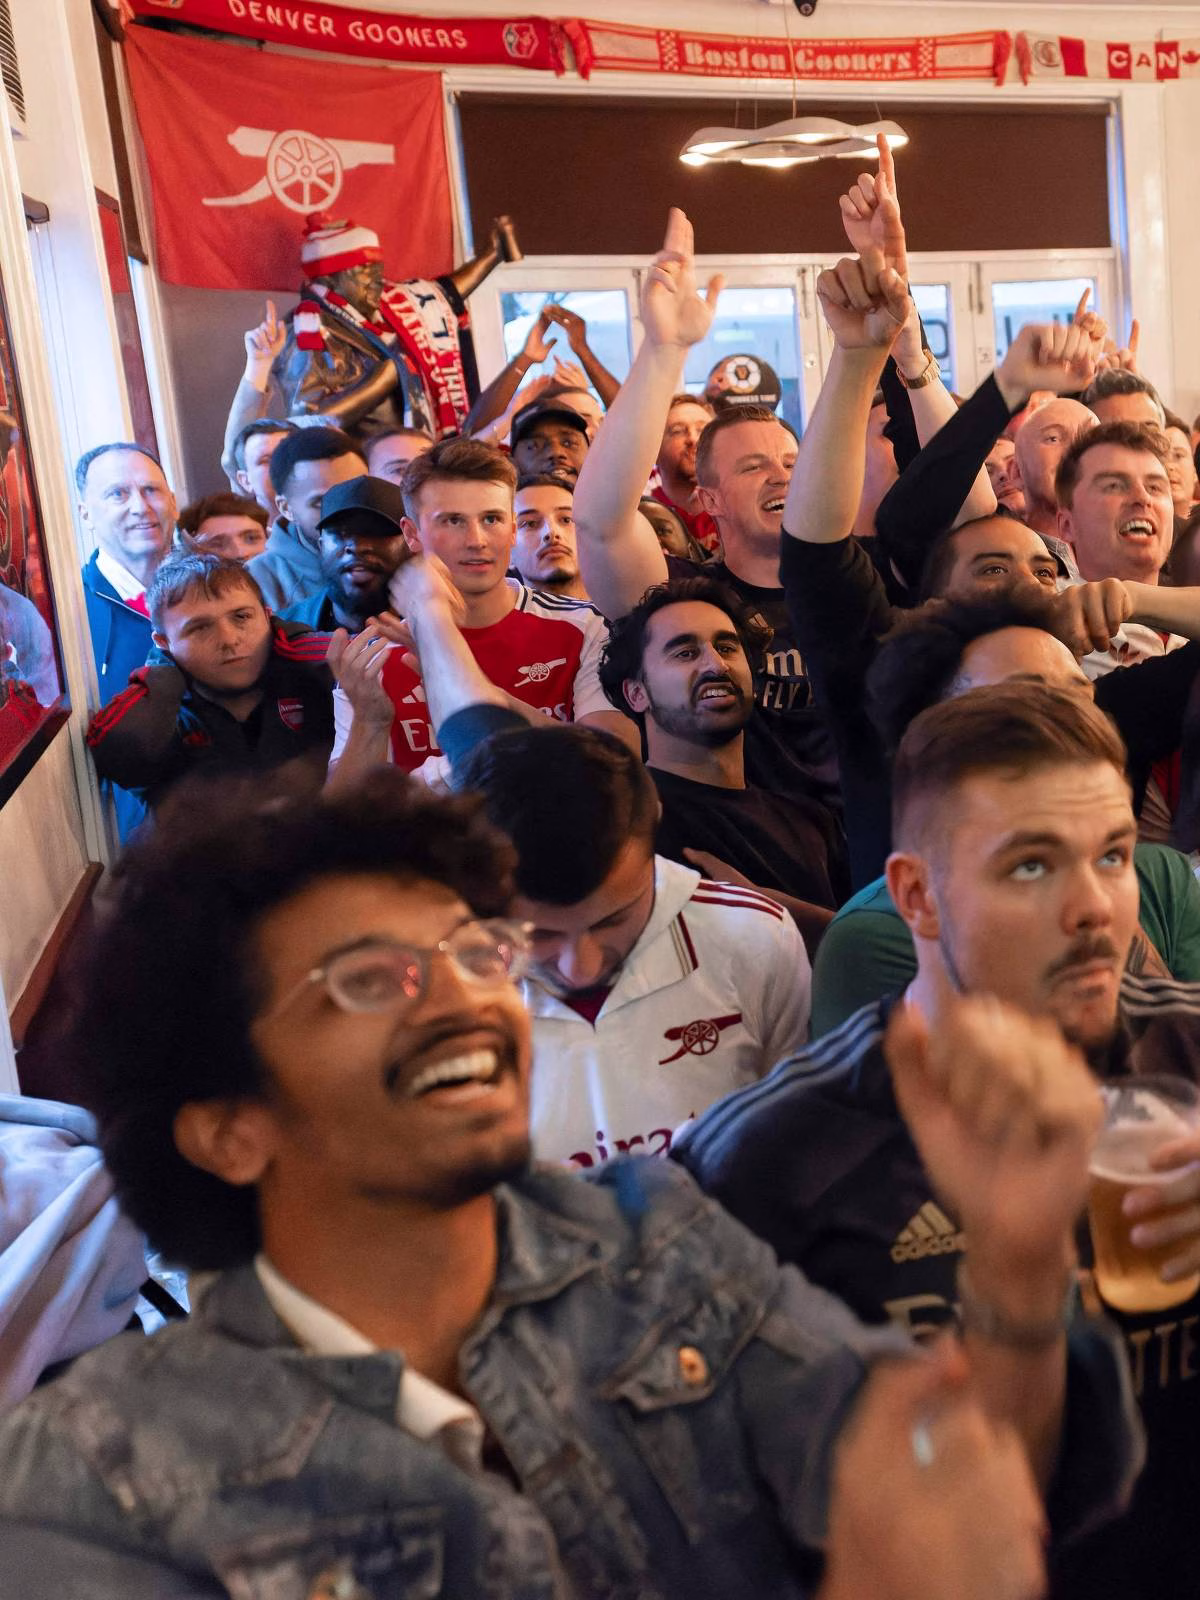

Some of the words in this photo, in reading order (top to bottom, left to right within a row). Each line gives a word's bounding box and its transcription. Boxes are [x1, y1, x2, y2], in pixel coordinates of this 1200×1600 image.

[229, 0, 337, 37] DENVER
[348, 20, 468, 49] GOONERS
[684, 41, 786, 70] Boston
[795, 48, 913, 71] Gooners
[890, 1234, 960, 1263] adida
